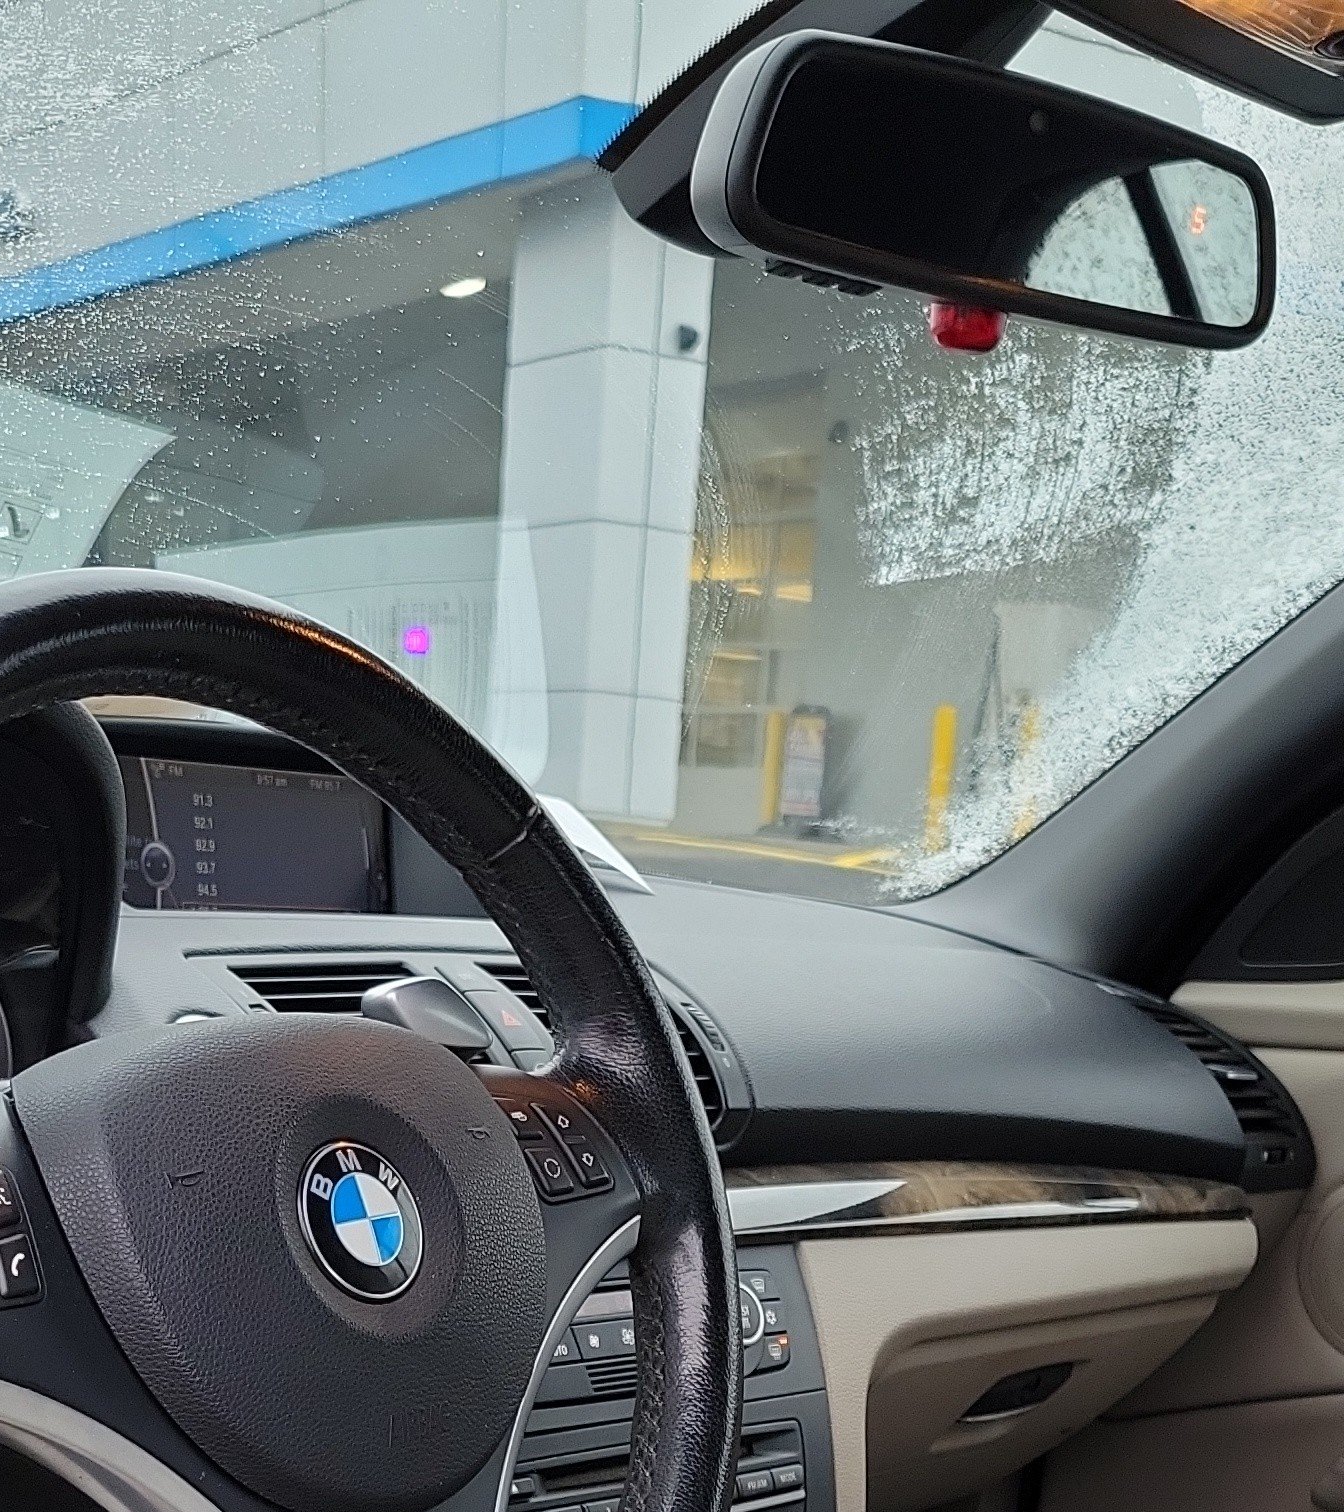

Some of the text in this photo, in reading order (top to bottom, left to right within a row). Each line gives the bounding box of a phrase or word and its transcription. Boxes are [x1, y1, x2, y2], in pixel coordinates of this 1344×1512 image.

[193, 793, 213, 807] 91.3
[194, 817, 214, 830] 92.1
[196, 839, 216, 852] 92.9
[196, 862, 217, 874] 93.7
[308, 1149, 403, 1203] BMW
